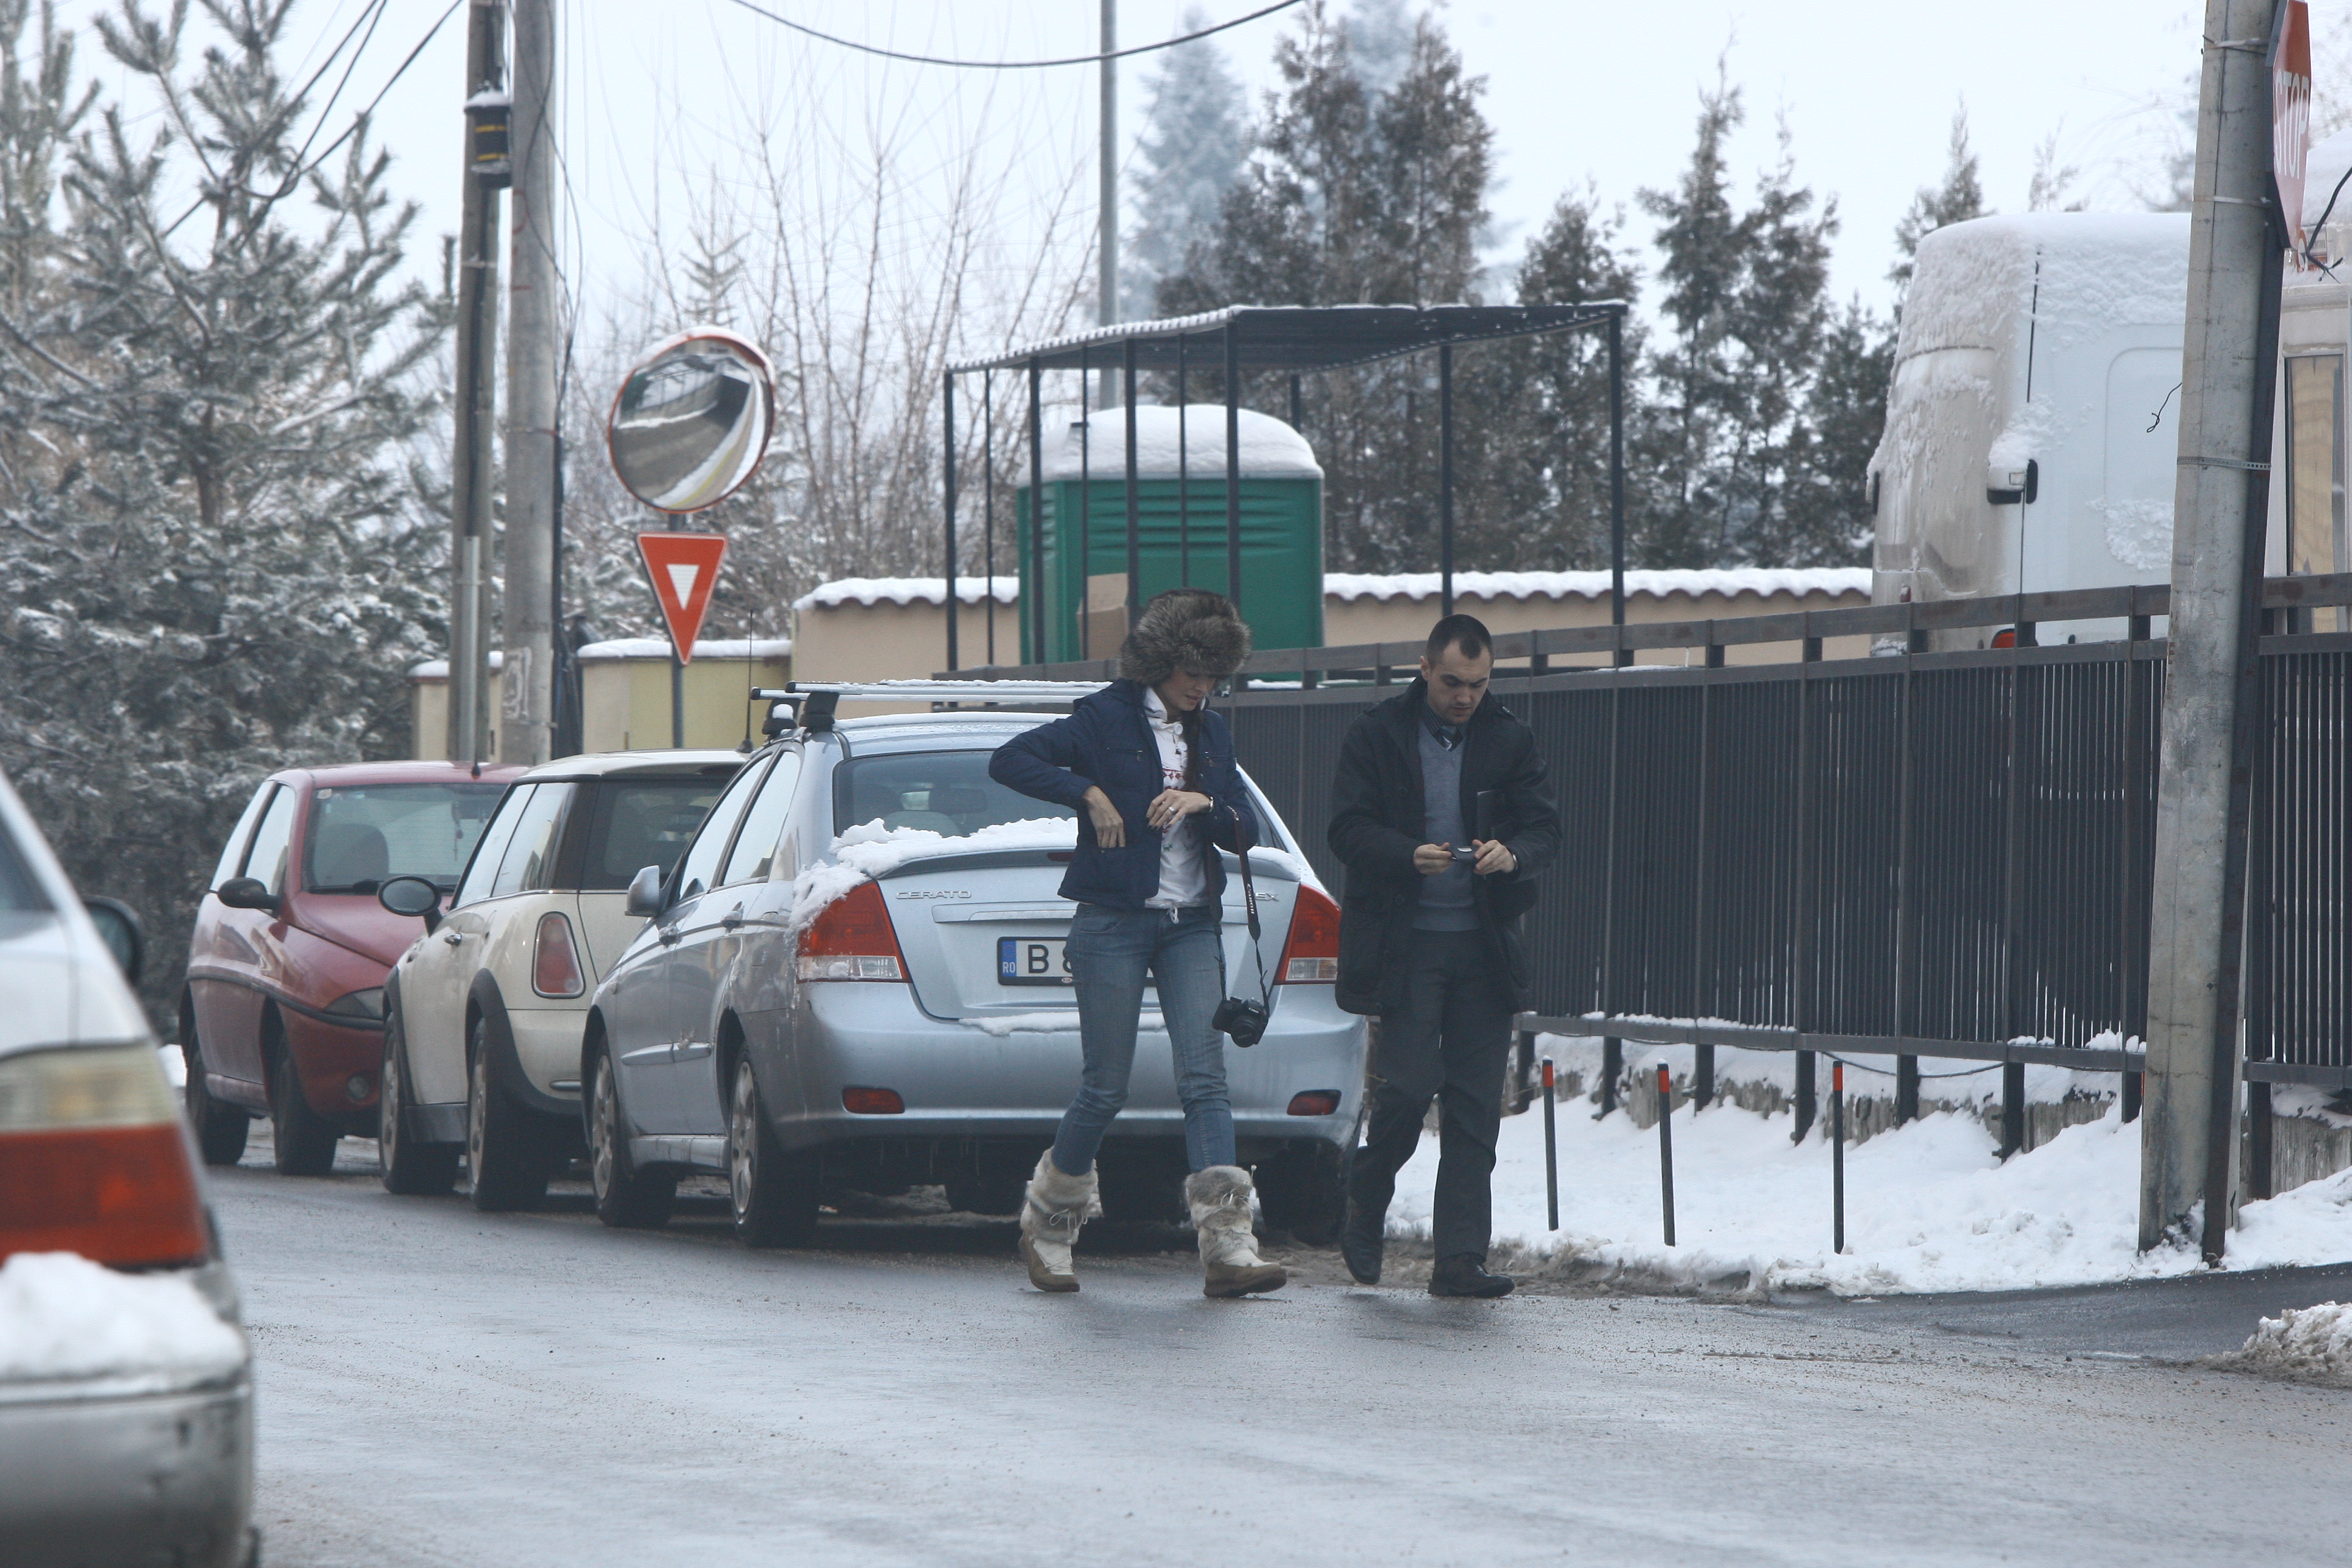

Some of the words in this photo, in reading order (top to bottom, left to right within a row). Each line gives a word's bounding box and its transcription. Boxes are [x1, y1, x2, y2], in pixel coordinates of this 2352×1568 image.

[2275, 68, 2309, 180] STOP
[896, 890, 972, 900] CERATO
[1255, 892, 1279, 901] EX
[1028, 944, 1049, 973] B
[1002, 961, 1015, 973] RO
